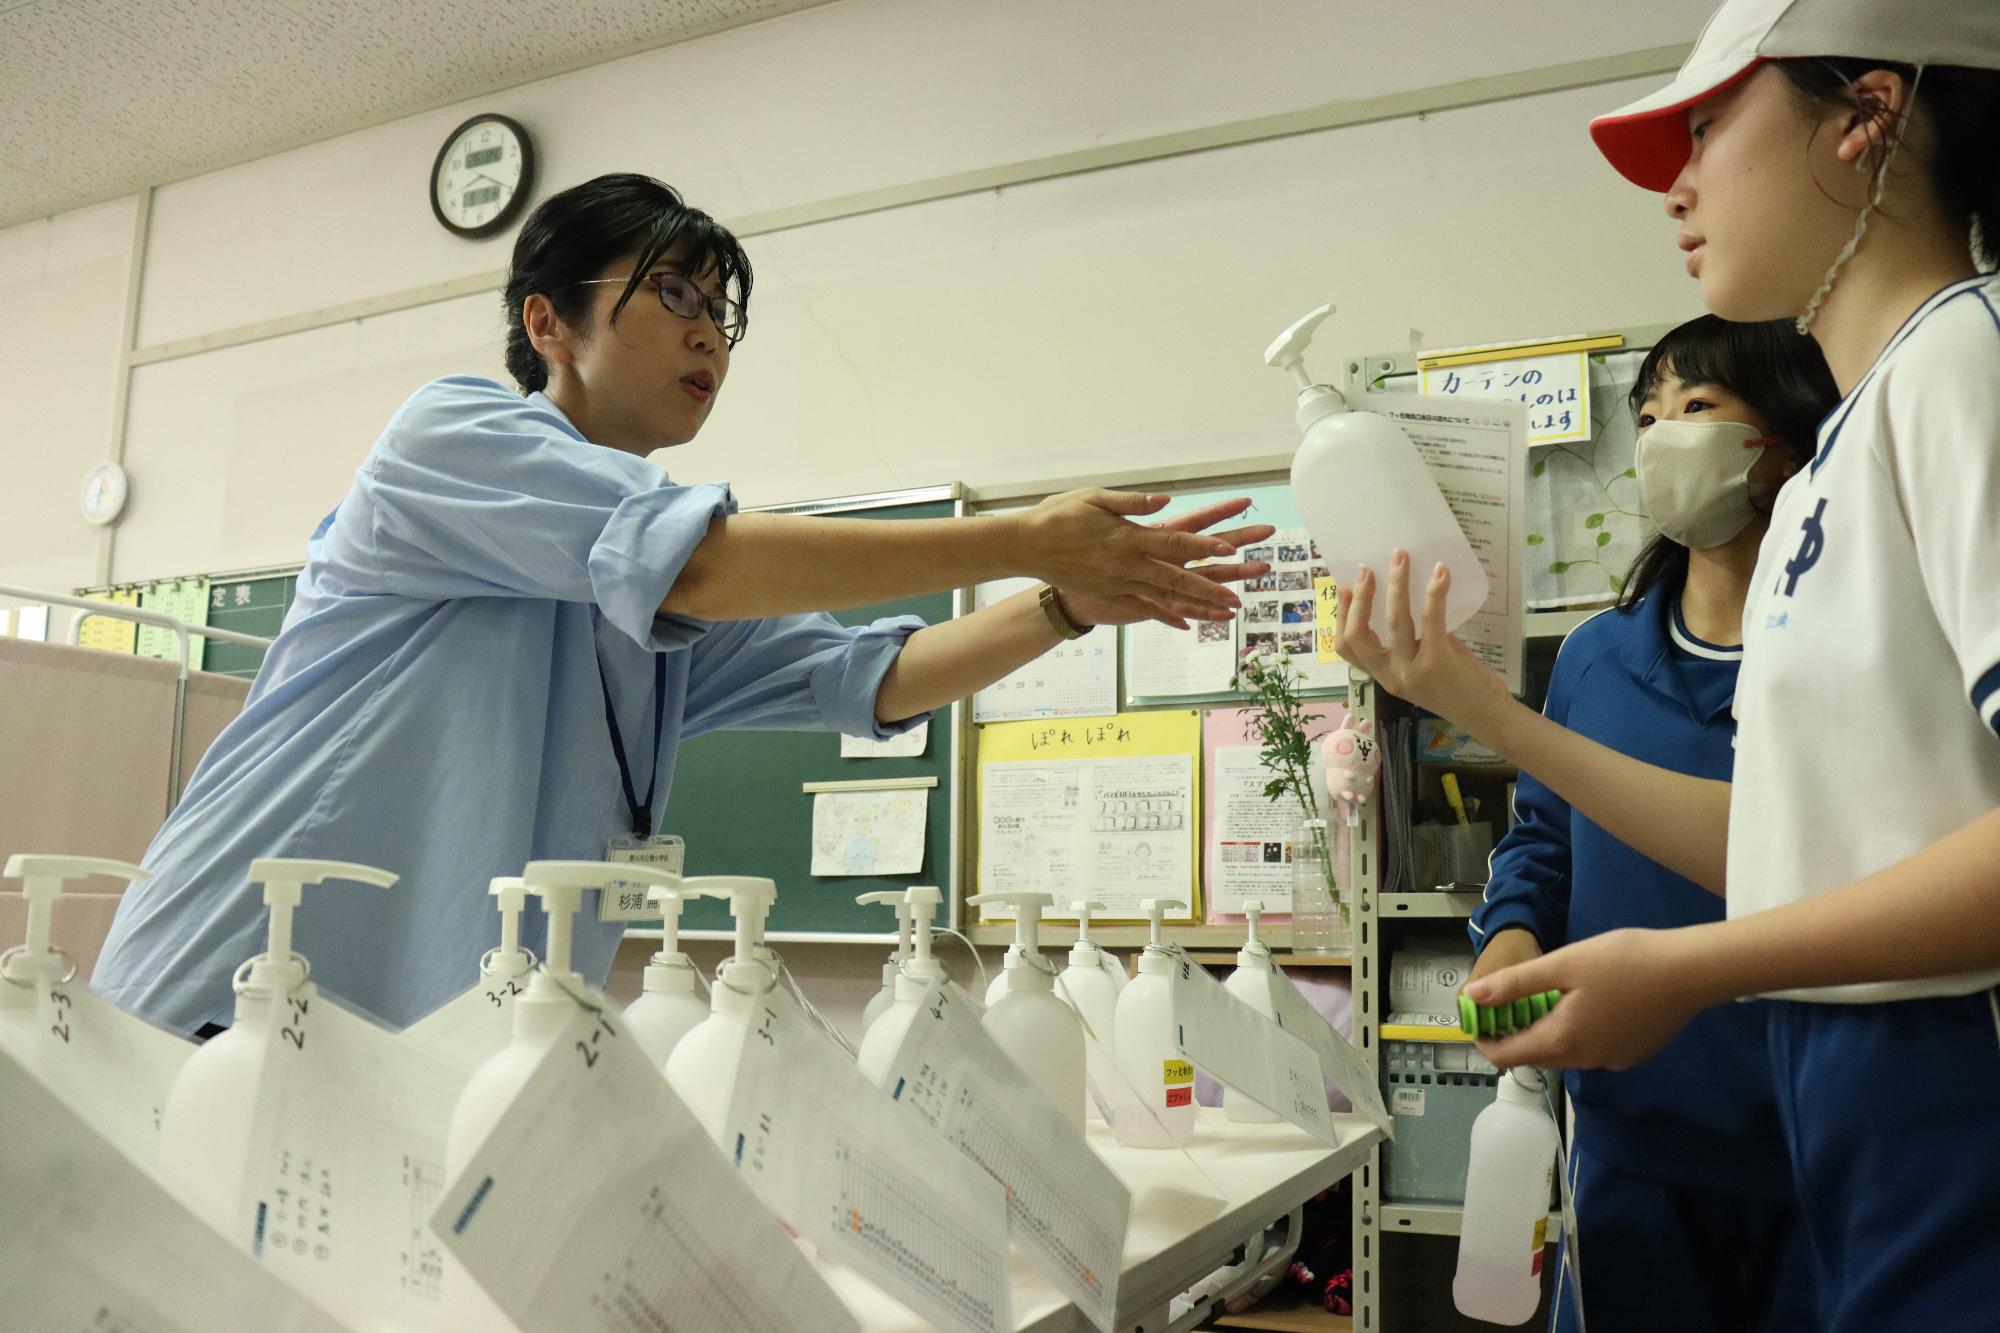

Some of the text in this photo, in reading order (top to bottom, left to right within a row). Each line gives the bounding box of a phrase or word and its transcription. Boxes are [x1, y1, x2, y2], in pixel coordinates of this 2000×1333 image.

[1441, 368, 1543, 393] カーテンの
[1031, 722, 1132, 750] ぽれ ぽれ
[618, 893, 644, 911] 杉浦
[486, 980, 523, 1008] 3-2
[929, 991, 949, 1021] 4-1
[50, 990, 72, 1045] 2-3
[281, 997, 309, 1050] 2-2
[757, 1007, 778, 1047] 3-1
[575, 1016, 618, 1069] 2-1
